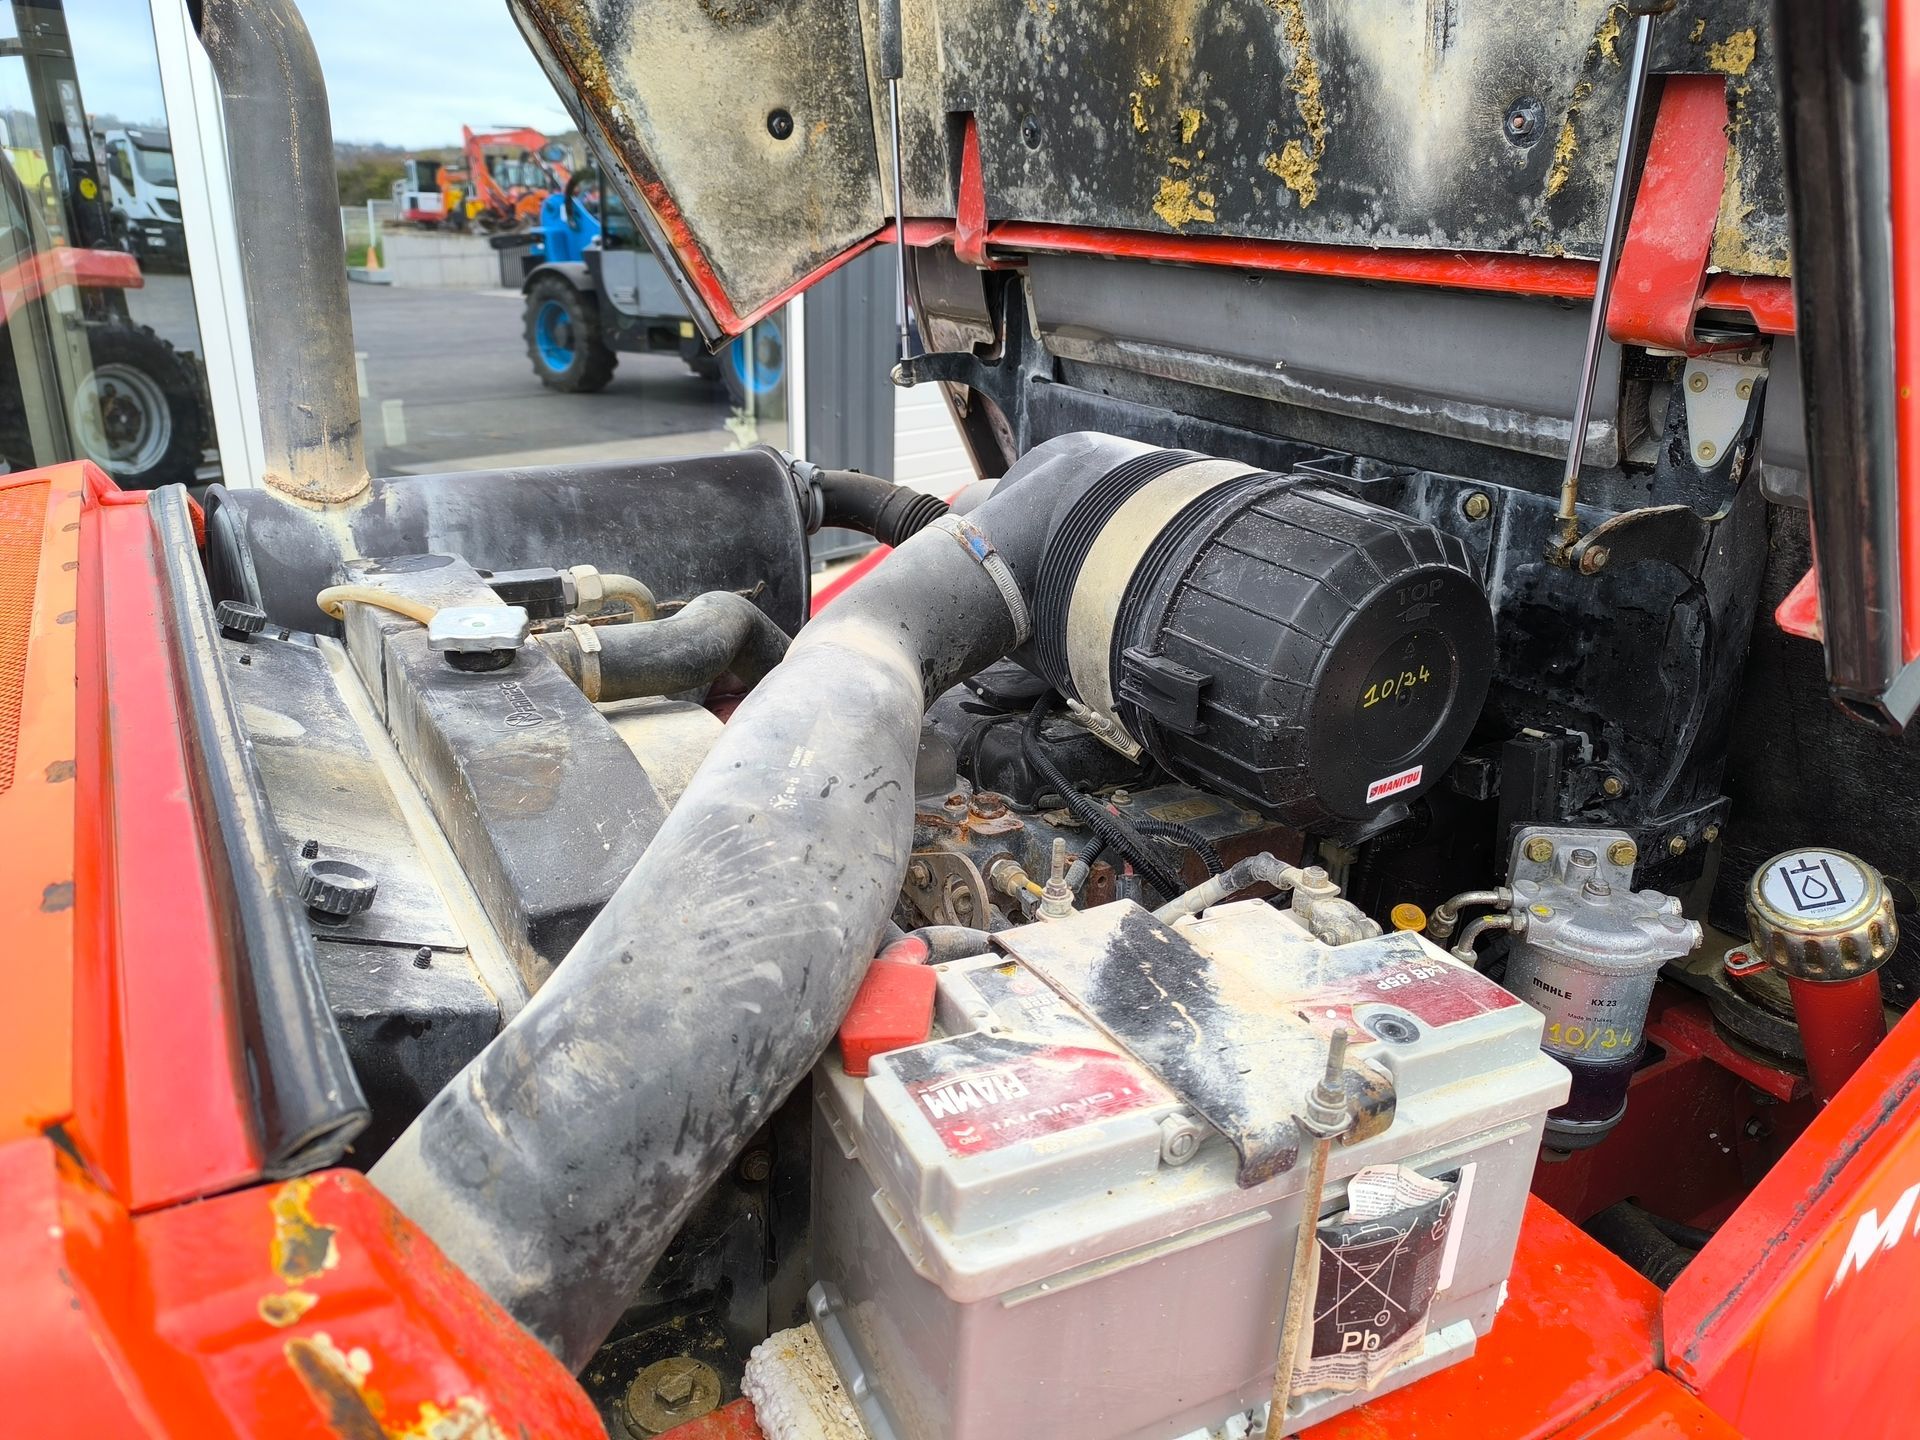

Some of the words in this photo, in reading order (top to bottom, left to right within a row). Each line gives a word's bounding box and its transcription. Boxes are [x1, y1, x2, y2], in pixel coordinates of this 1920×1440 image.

[1395, 578, 1444, 606] TOP
[1363, 664, 1430, 708] 10/24
[1377, 770, 1421, 796] MANITOU
[1376, 973, 1411, 990] 85P
[1412, 965, 1448, 981] L4B
[1532, 977, 1573, 1001] MAHLE
[1591, 999, 1605, 1007] KX
[1567, 1012, 1584, 1021] Made
[1548, 1023, 1632, 1051] 10/24
[920, 1073, 1030, 1119] FIAMM
[959, 1134, 983, 1146] PRO
[1823, 1181, 1920, 1301] M
[1340, 1329, 1381, 1353] Pb
